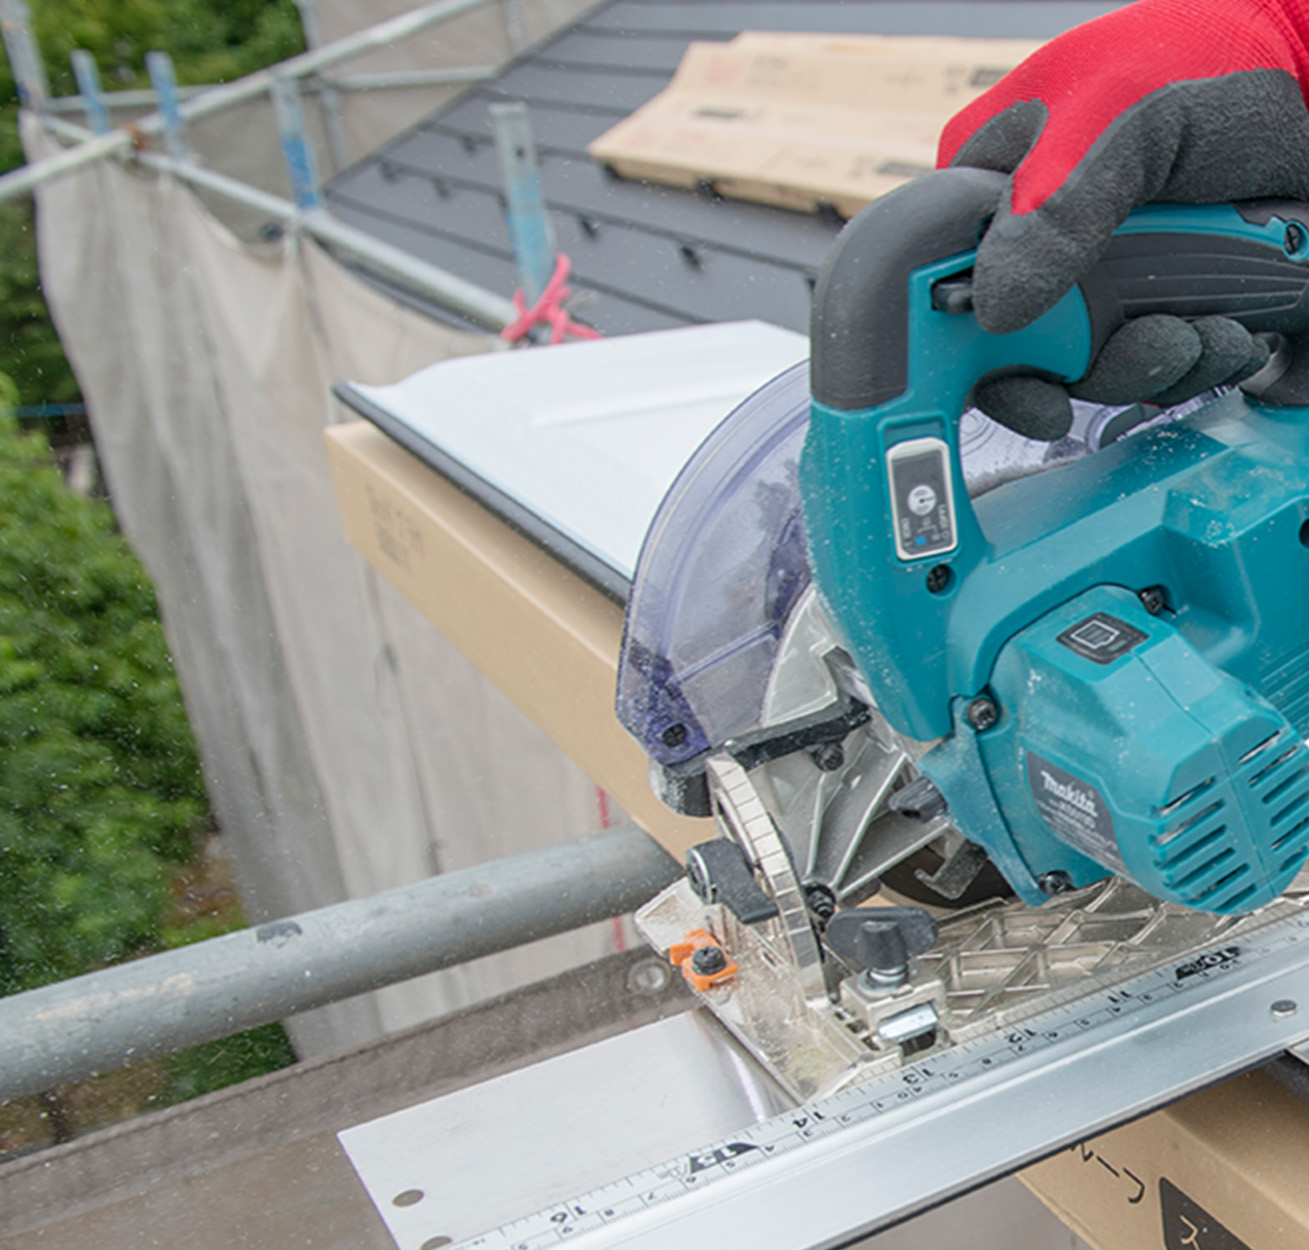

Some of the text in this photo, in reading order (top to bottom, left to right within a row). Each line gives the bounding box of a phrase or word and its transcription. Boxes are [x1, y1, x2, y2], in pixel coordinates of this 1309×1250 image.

[1008, 1028, 1037, 1043] 12
[902, 1068, 933, 1085] 13
[793, 1111, 825, 1128] 14
